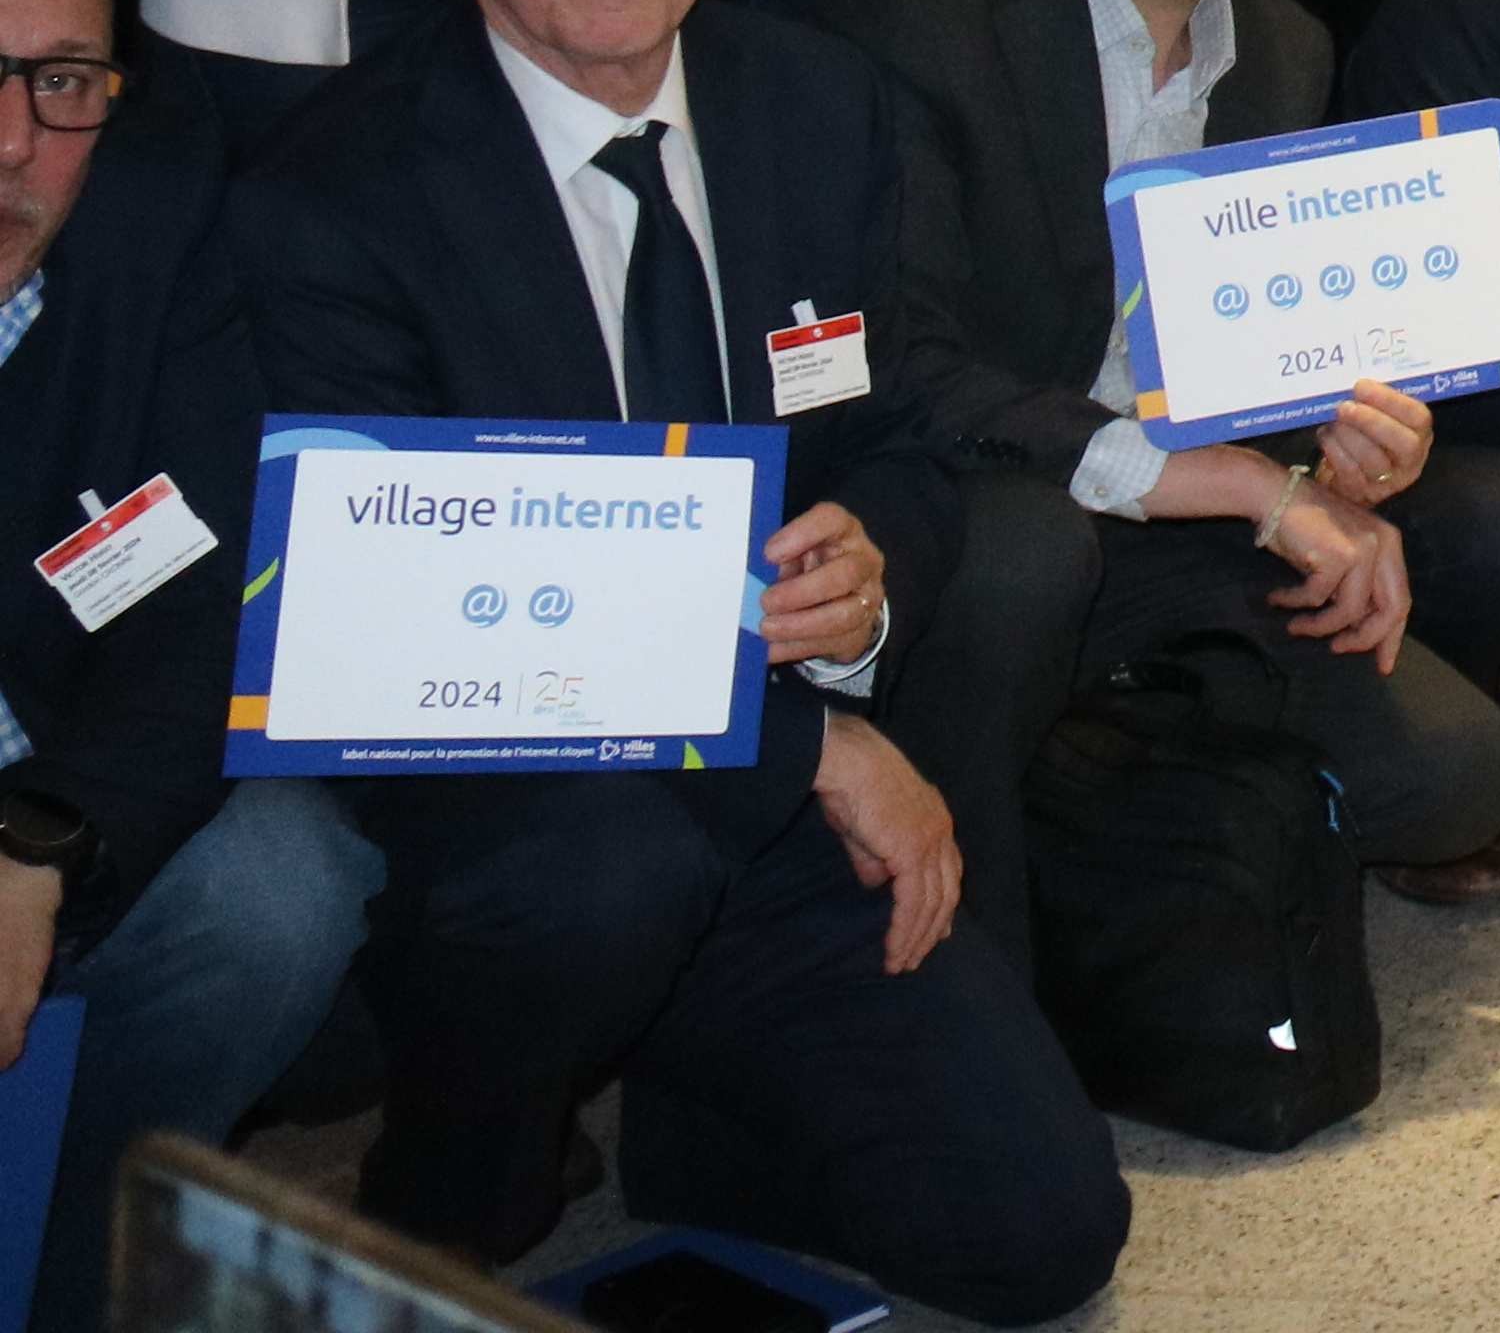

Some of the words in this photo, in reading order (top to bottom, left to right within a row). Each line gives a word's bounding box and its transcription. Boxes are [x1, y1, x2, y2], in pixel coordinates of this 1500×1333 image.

[1203, 196, 1279, 238] ville
[1286, 168, 1446, 225] internet
[1277, 343, 1346, 378] 2024
[346, 482, 498, 537] village
[509, 485, 704, 532] internet
[418, 679, 503, 709] 2024
